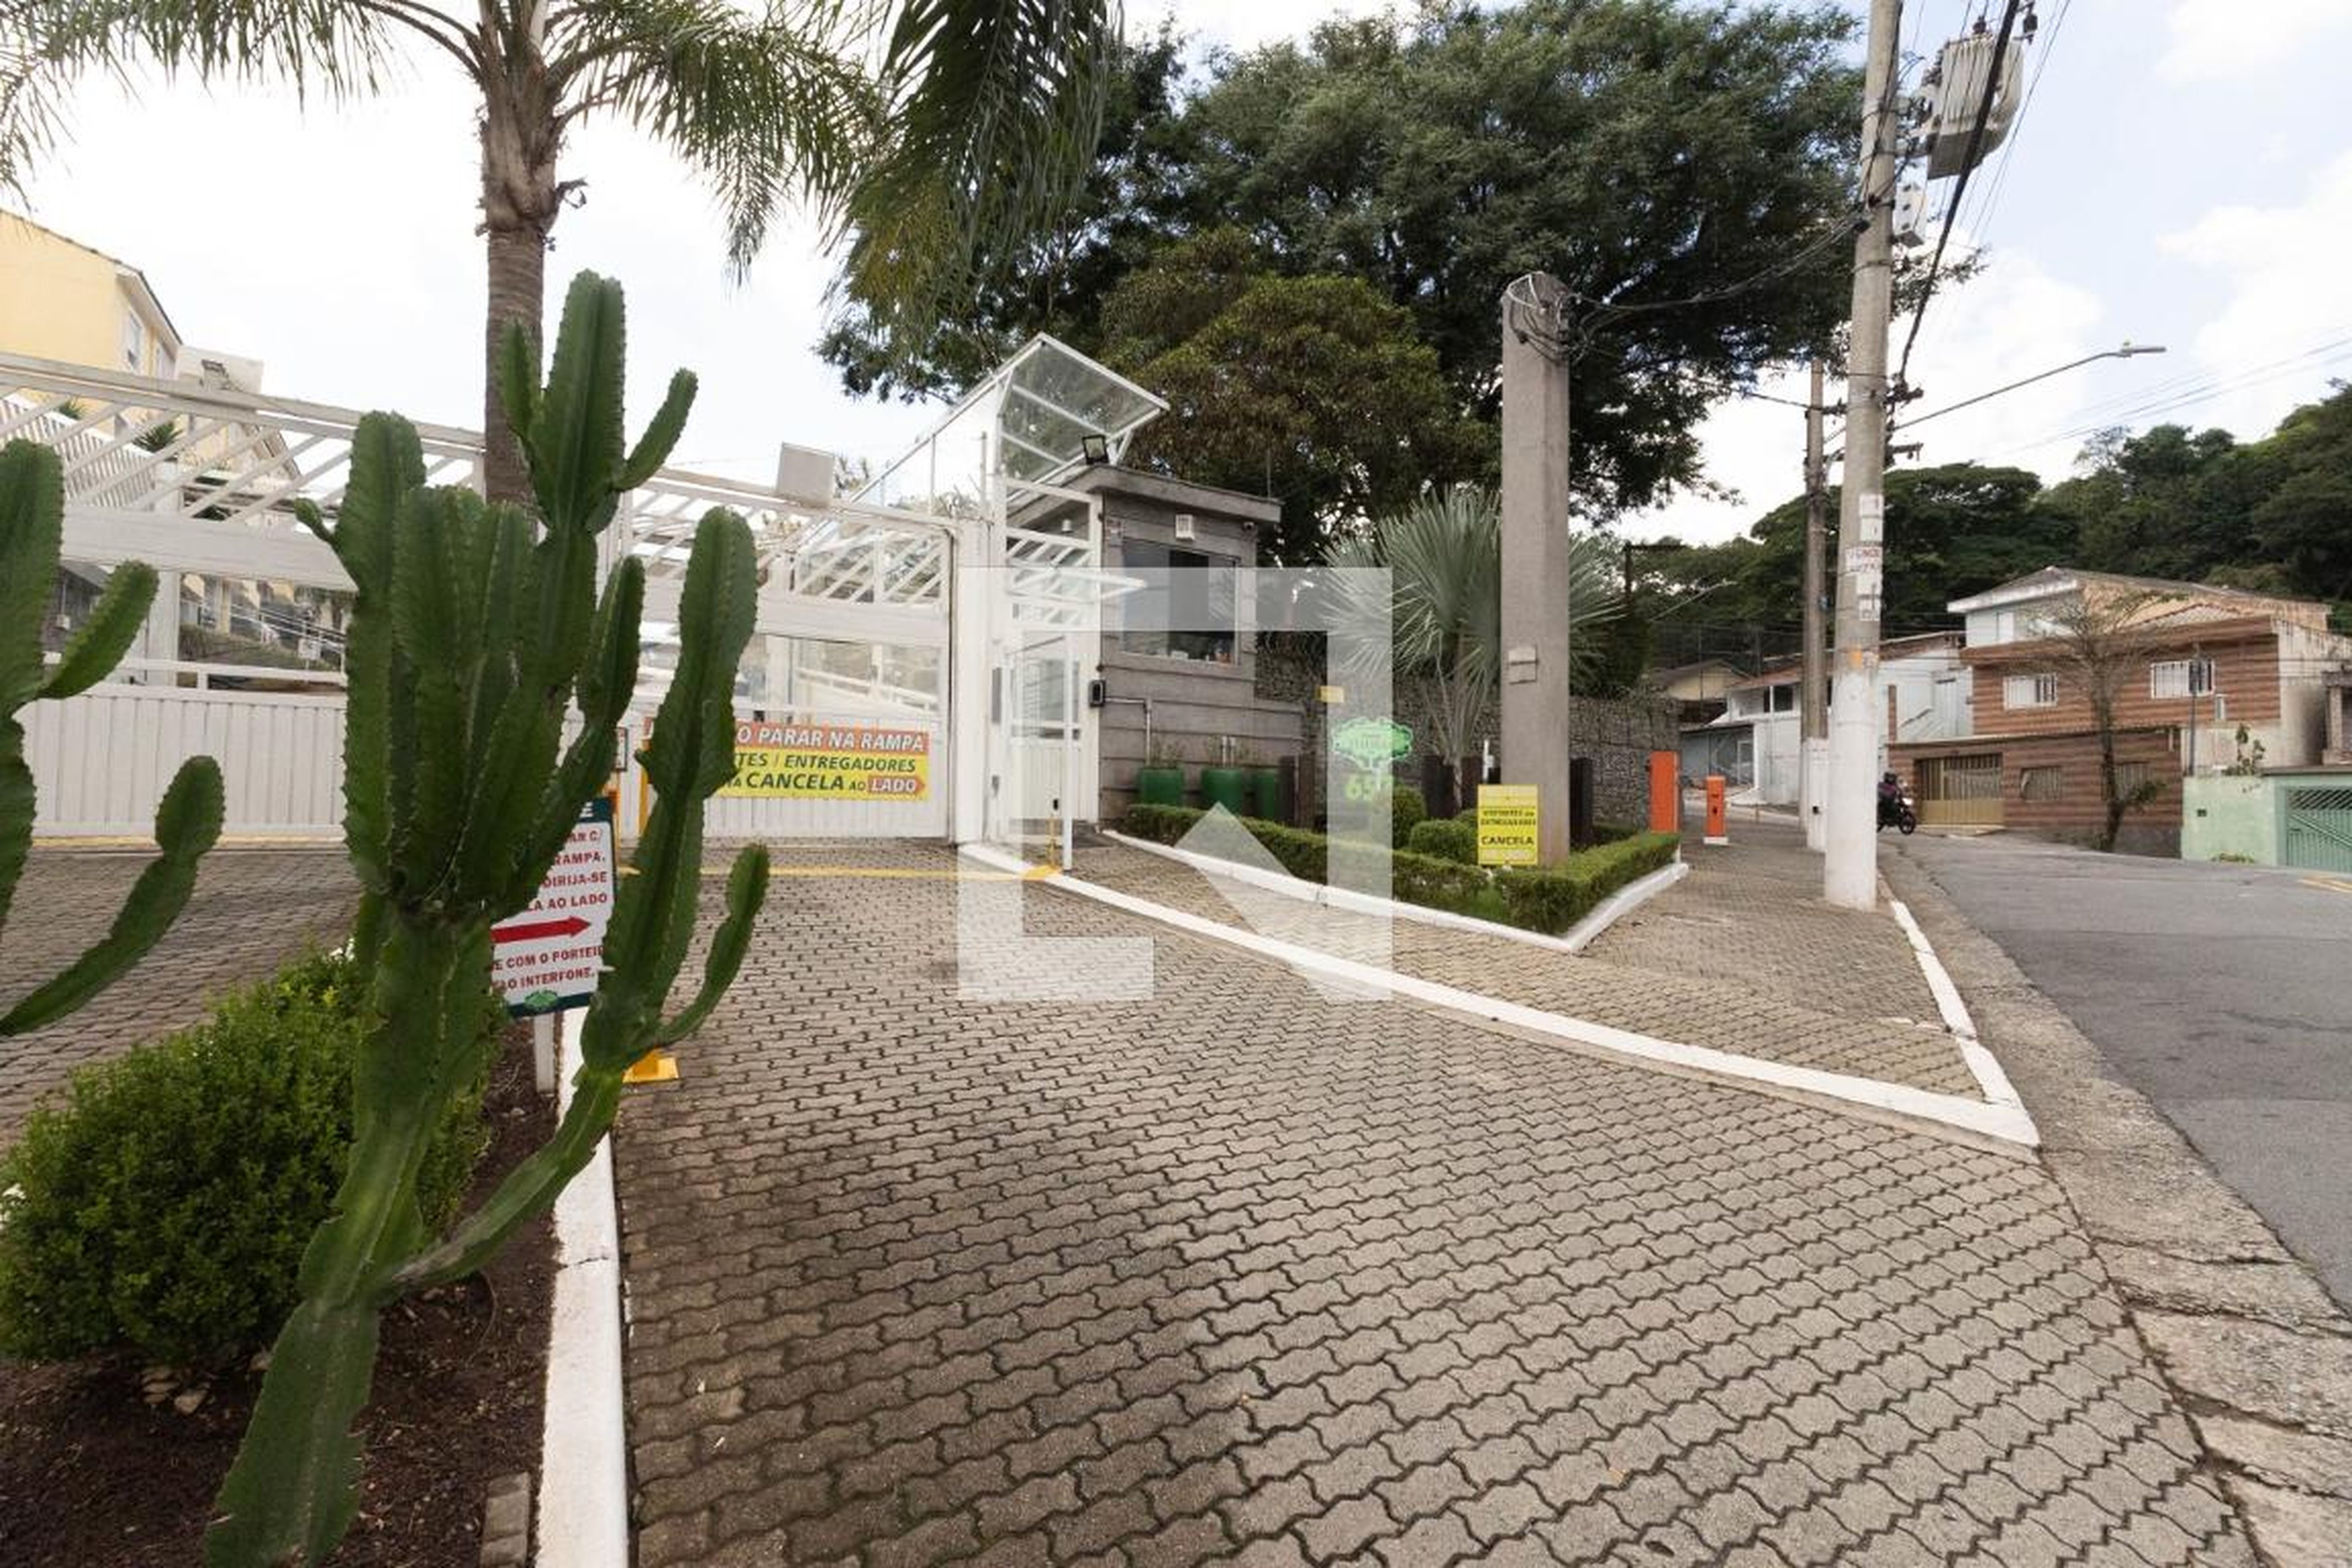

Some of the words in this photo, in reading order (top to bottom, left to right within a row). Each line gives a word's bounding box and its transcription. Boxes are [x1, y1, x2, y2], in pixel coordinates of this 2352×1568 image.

[737, 725, 752, 743] O
[758, 727, 823, 747] PARAR
[829, 731, 854, 749] NA
[861, 732, 924, 752] RAMPA
[734, 752, 768, 767] TES
[785, 754, 916, 772] ENTREGADORES
[746, 772, 844, 791] CANCELA
[849, 780, 866, 791] AO
[872, 778, 916, 793] LADO
[548, 897, 567, 910] AO
[571, 892, 608, 908] LADO
[506, 954, 537, 968] COM
[540, 952, 549, 964] O
